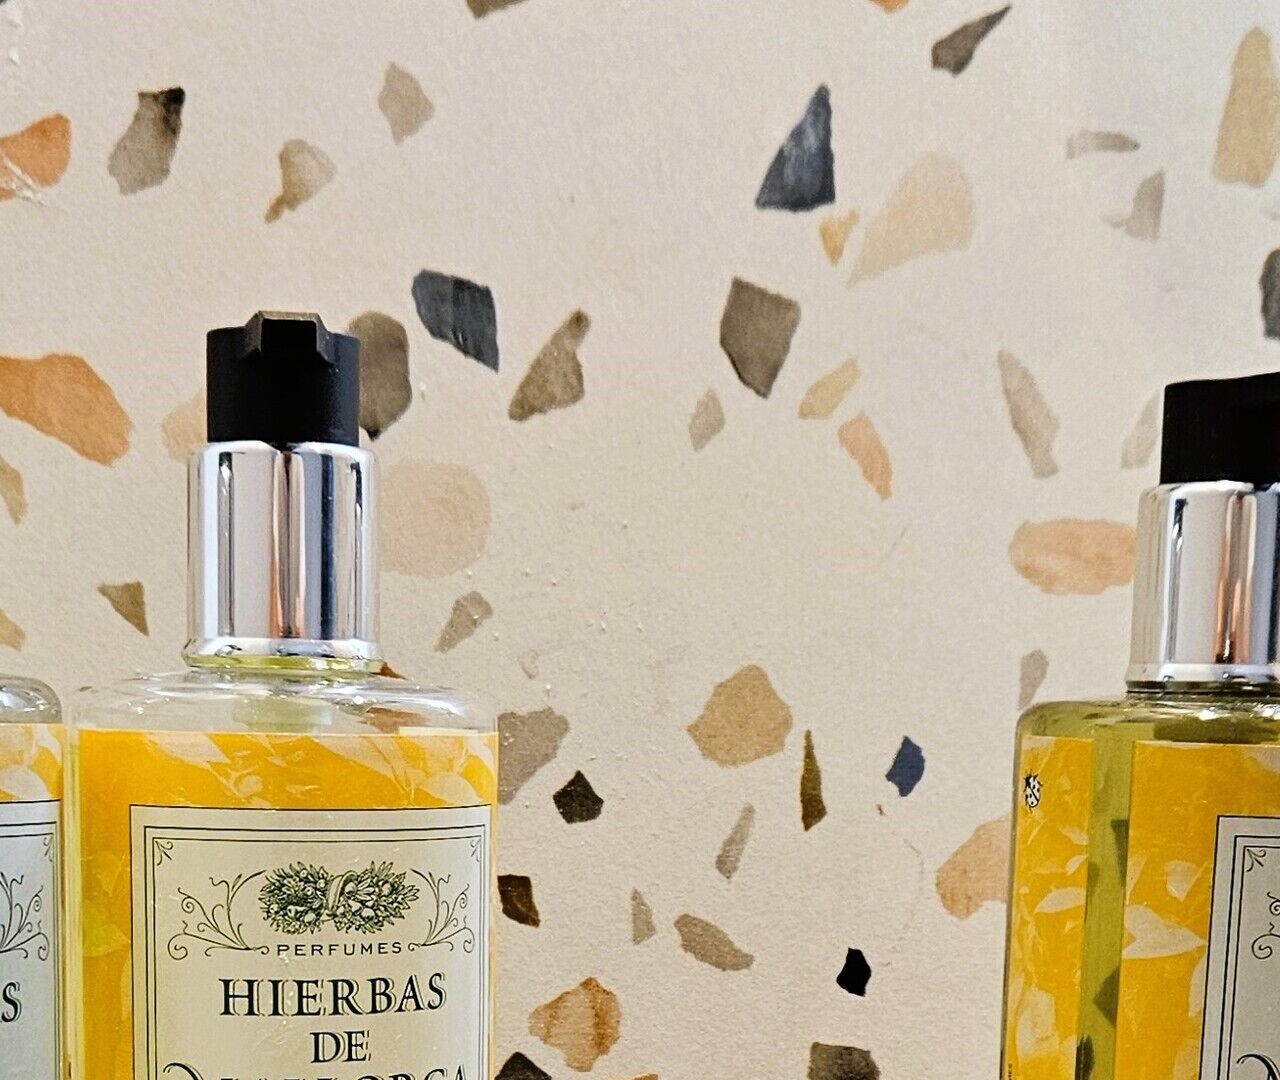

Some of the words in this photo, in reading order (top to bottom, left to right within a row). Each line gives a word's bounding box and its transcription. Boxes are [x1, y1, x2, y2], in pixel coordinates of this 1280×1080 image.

[277, 941, 403, 957] PERFUMES
[219, 971, 446, 1017] HIERBAS
[310, 1030, 371, 1064] DE
